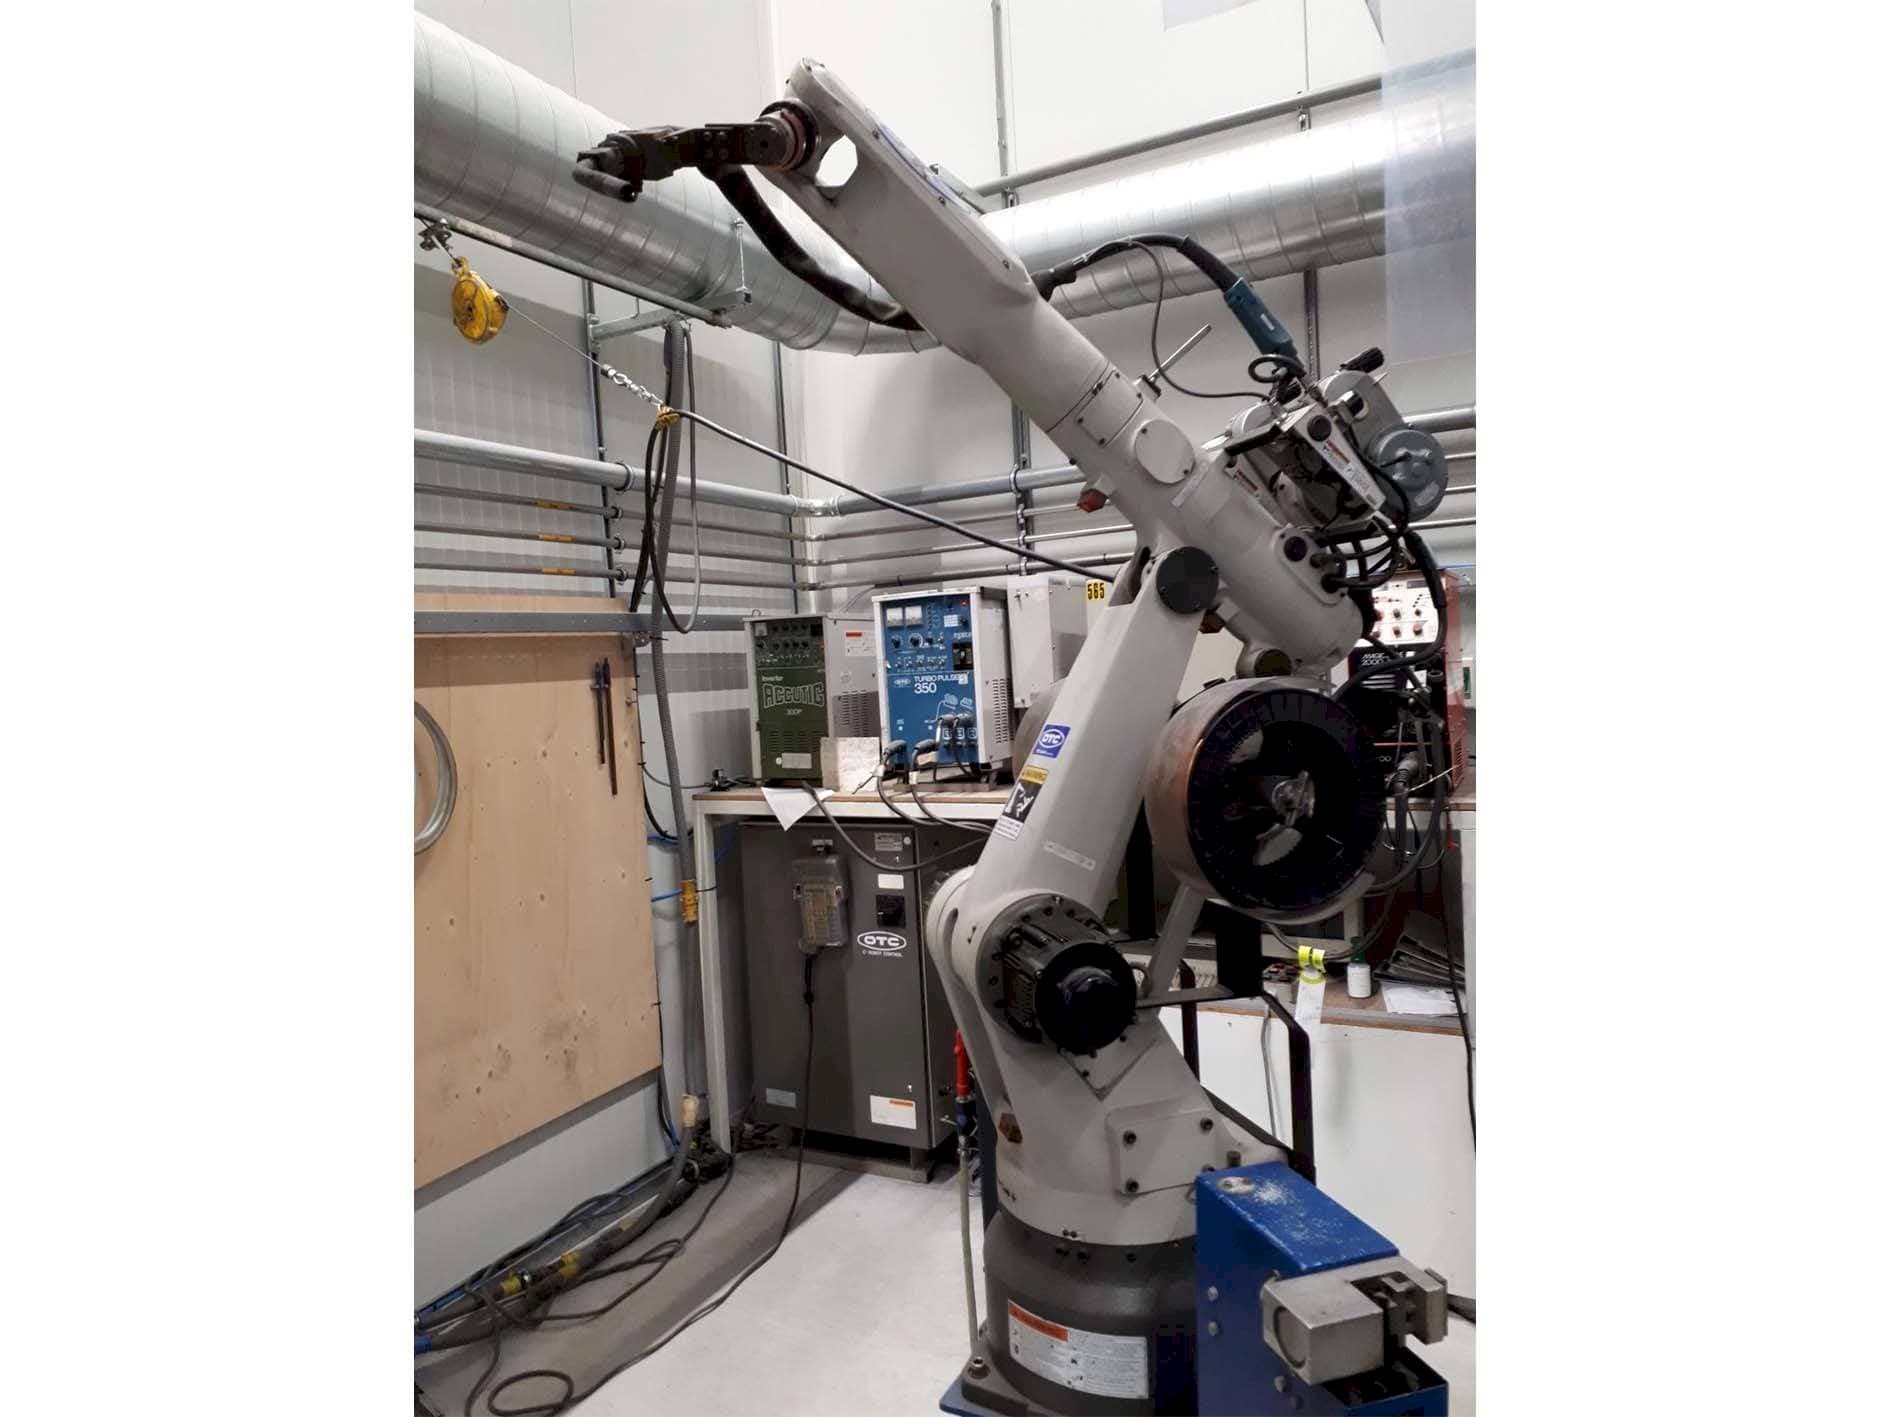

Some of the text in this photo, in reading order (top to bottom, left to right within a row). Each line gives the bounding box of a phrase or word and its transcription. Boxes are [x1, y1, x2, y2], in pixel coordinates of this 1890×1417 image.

[914, 682, 937, 694] 350
[1042, 733, 1061, 744] OTC
[864, 935, 900, 947] OTC
